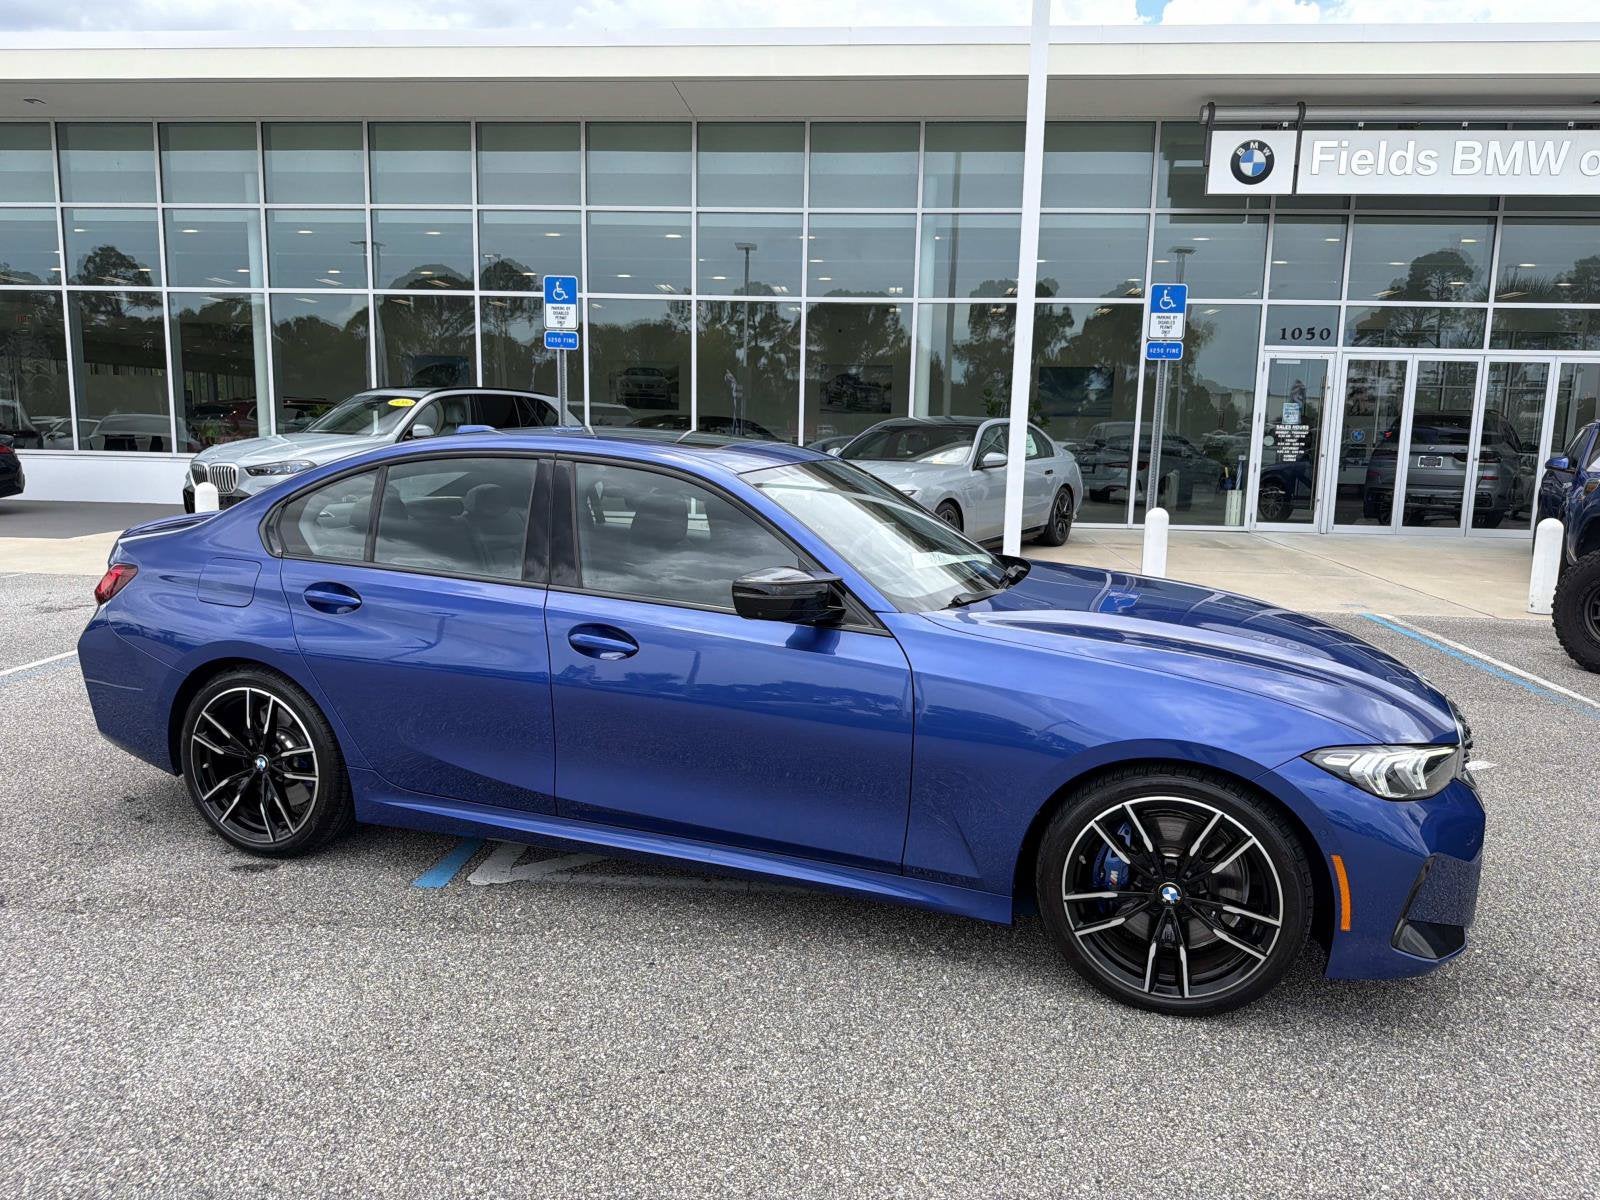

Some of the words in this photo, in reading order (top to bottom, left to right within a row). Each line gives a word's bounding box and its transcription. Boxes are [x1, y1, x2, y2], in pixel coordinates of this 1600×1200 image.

[1236, 141, 1272, 157] BMW
[1310, 139, 1441, 177] Fields
[1451, 139, 1572, 177] BMW
[1279, 326, 1331, 341] 1050
